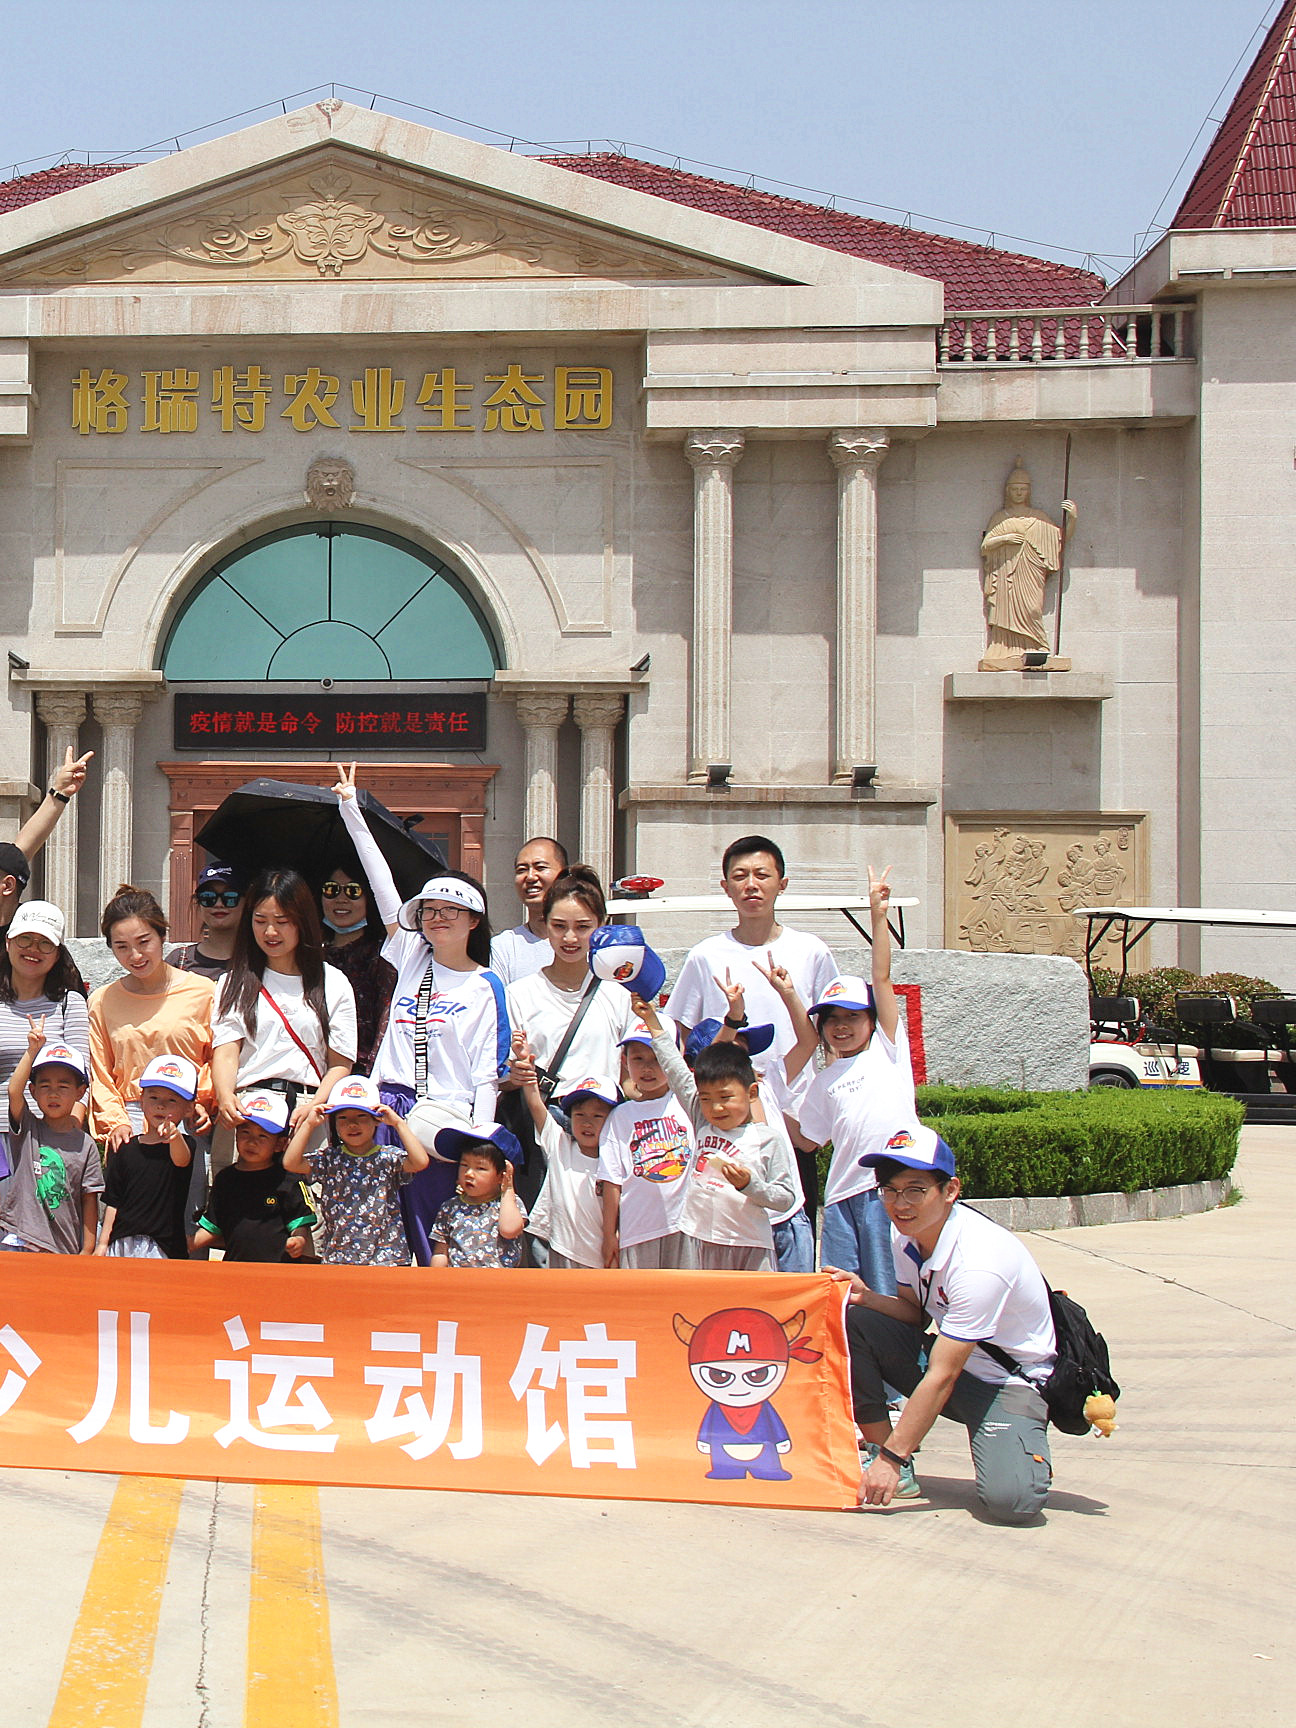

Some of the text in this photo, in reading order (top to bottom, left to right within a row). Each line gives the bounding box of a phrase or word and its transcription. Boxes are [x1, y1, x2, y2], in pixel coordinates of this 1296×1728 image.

[71, 364, 614, 436] 格瑞特农业生态园
[189, 711, 470, 735] 疫情就是命令 防控就是责任
